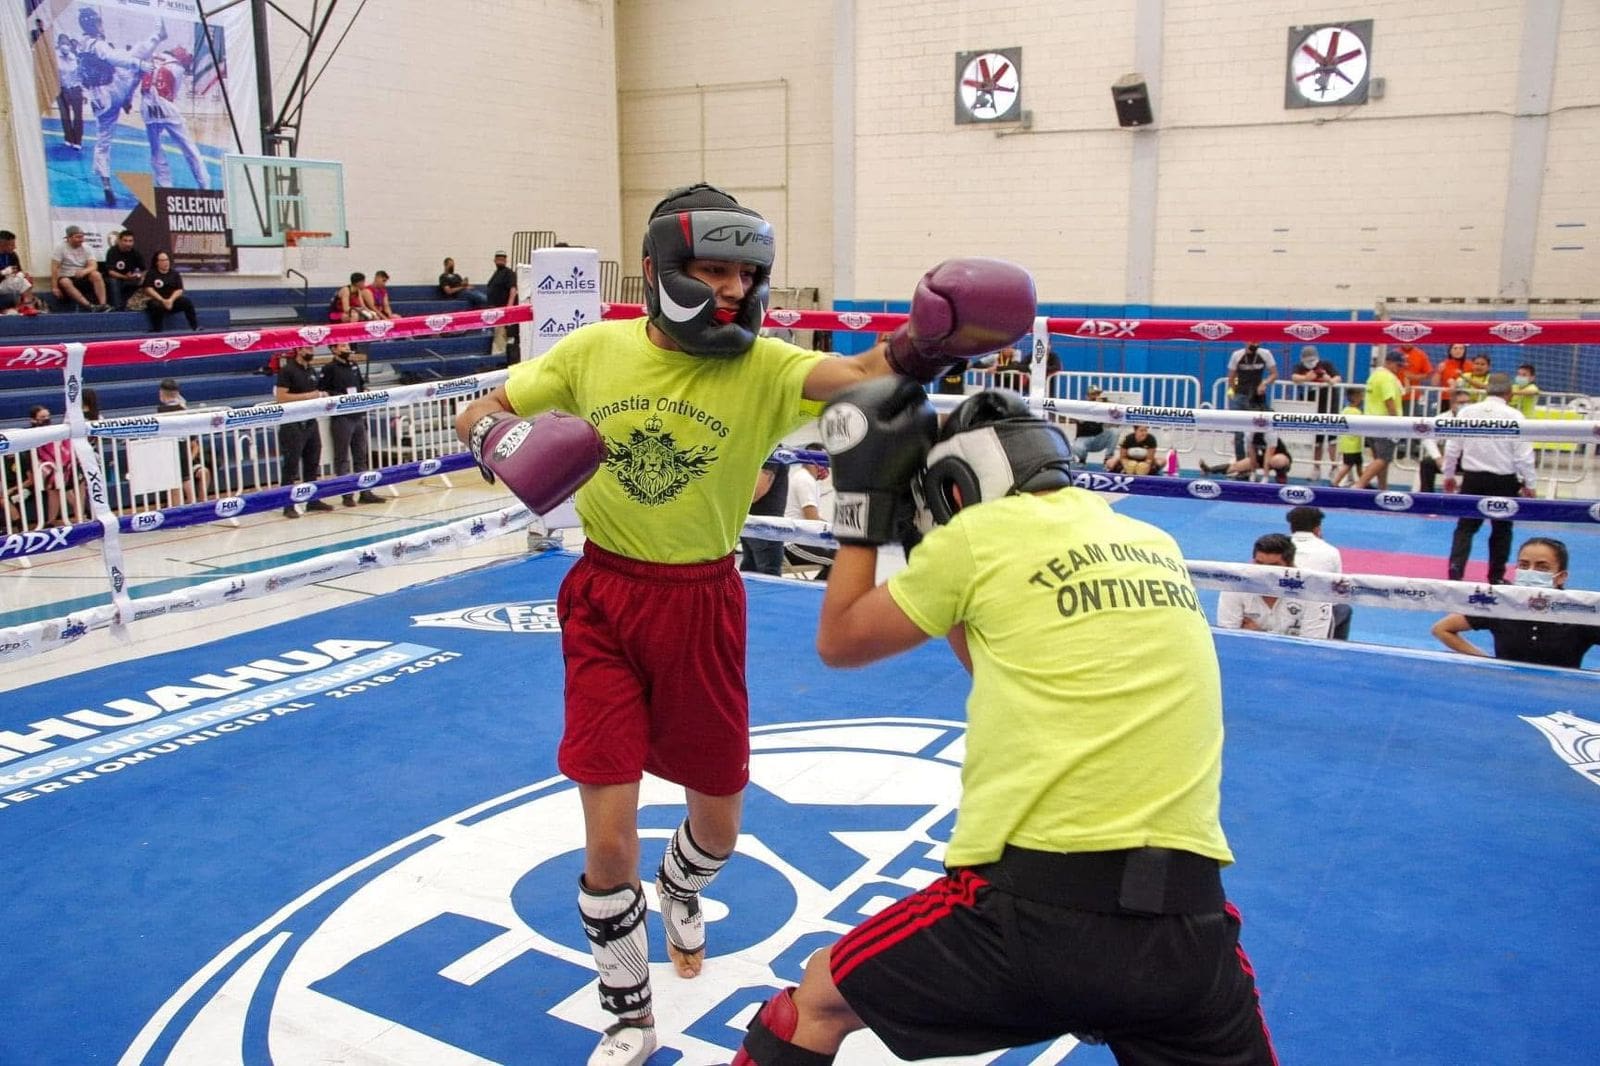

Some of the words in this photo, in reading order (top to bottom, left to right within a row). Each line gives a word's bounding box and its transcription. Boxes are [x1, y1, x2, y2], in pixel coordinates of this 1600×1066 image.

[168, 214, 225, 232] NACIONAL
[555, 278, 596, 290] ARIES
[1075, 320, 1140, 338] ADX
[6, 347, 67, 367] AD
[338, 390, 390, 404] CHIHUAHUA
[226, 405, 285, 418] CHIHUAHUA
[656, 397, 730, 438] Ontiveros
[1126, 406, 1195, 418] CHIHUAHUA
[1272, 413, 1348, 425] CHIHUAHUA
[1434, 418, 1520, 429] CHIHUAHUA
[1072, 472, 1135, 491] ADX
[1195, 483, 1213, 492] FOX
[1286, 488, 1306, 497] FOX
[222, 500, 239, 510] FOX
[1383, 495, 1405, 505] FOX
[1486, 500, 1509, 511] FOX
[138, 515, 157, 526] FOX
[0, 525, 74, 557] ADX
[1028, 543, 1109, 590] TEAM
[1056, 578, 1206, 619] ONTIVERO
[325, 651, 463, 698] 2018-2021
[86, 724, 184, 755] una
[180, 686, 298, 728] mejor
[294, 650, 411, 692] ciudad
